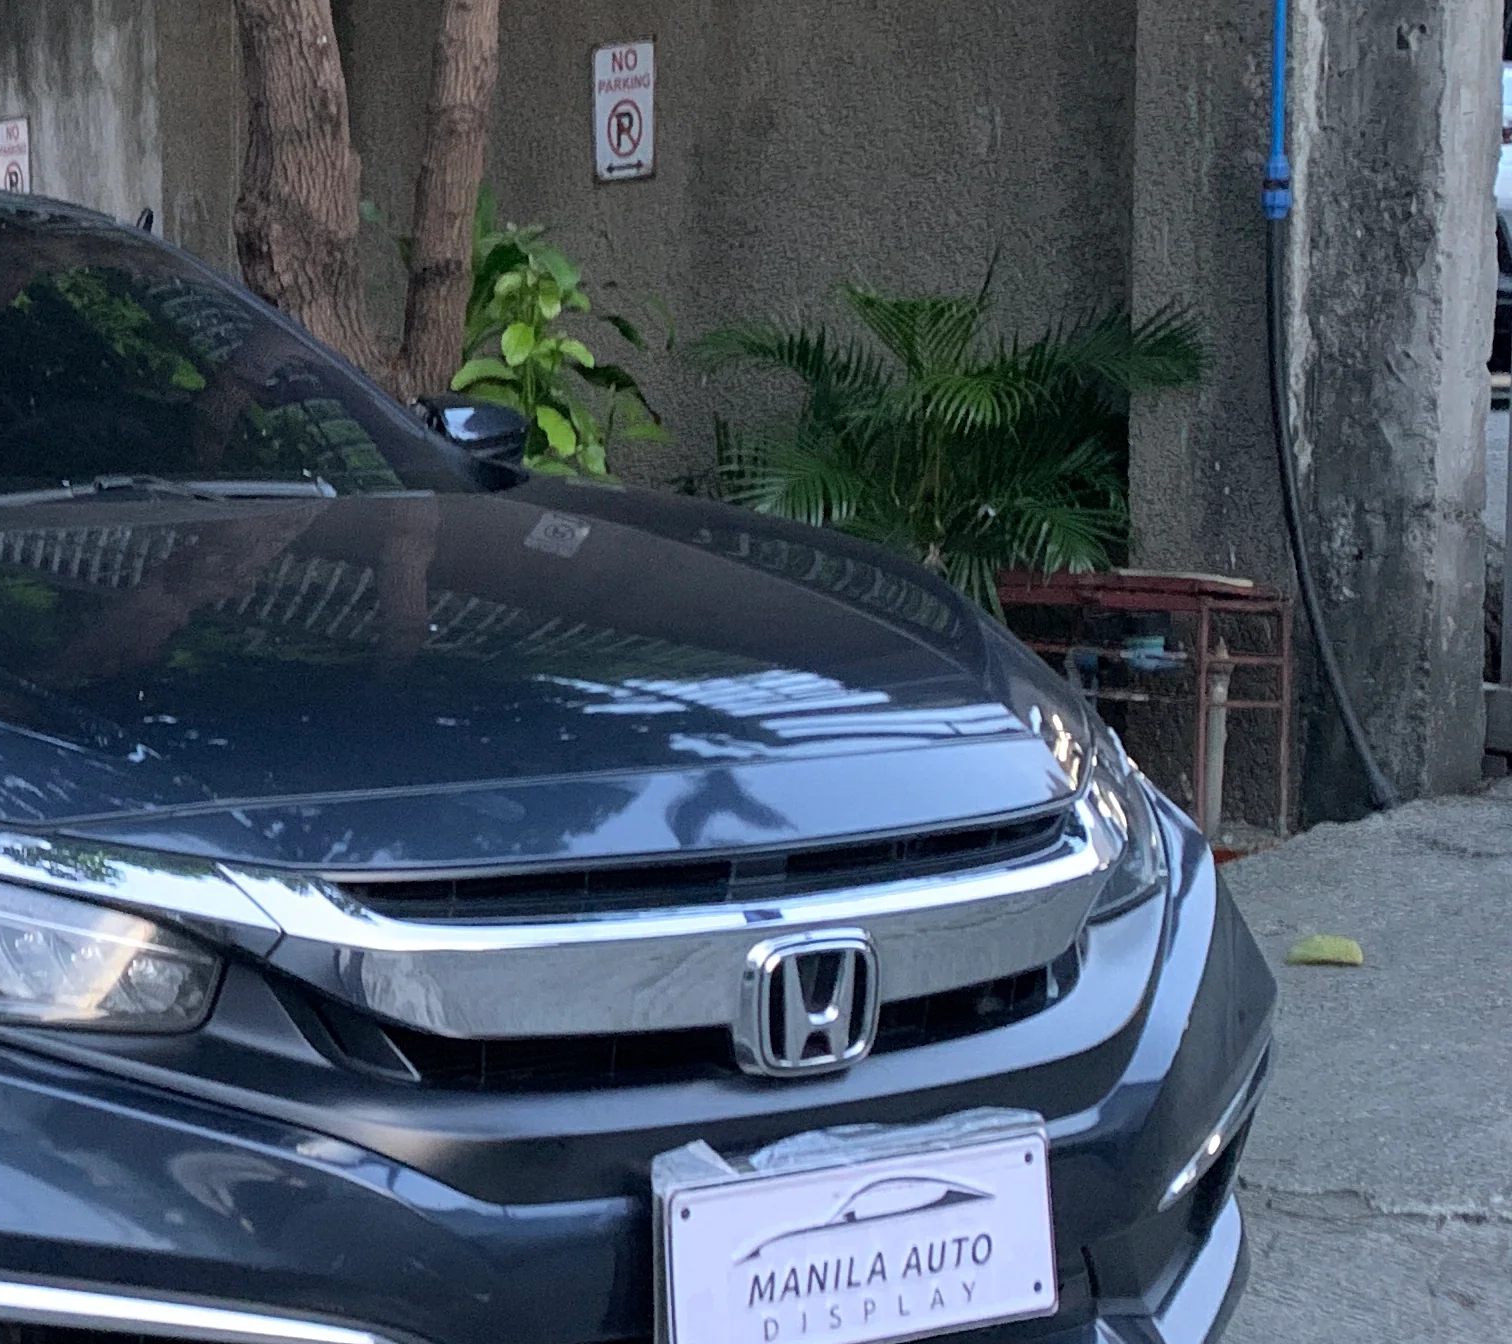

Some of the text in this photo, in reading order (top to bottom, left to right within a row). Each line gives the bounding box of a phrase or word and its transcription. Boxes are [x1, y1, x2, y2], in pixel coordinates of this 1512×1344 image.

[612, 48, 638, 72] NO
[598, 73, 650, 94] PARKING
[7, 123, 19, 140] NO
[748, 1233, 994, 1308] MANILA AUTO
[764, 1281, 976, 1343] DISPLAY
